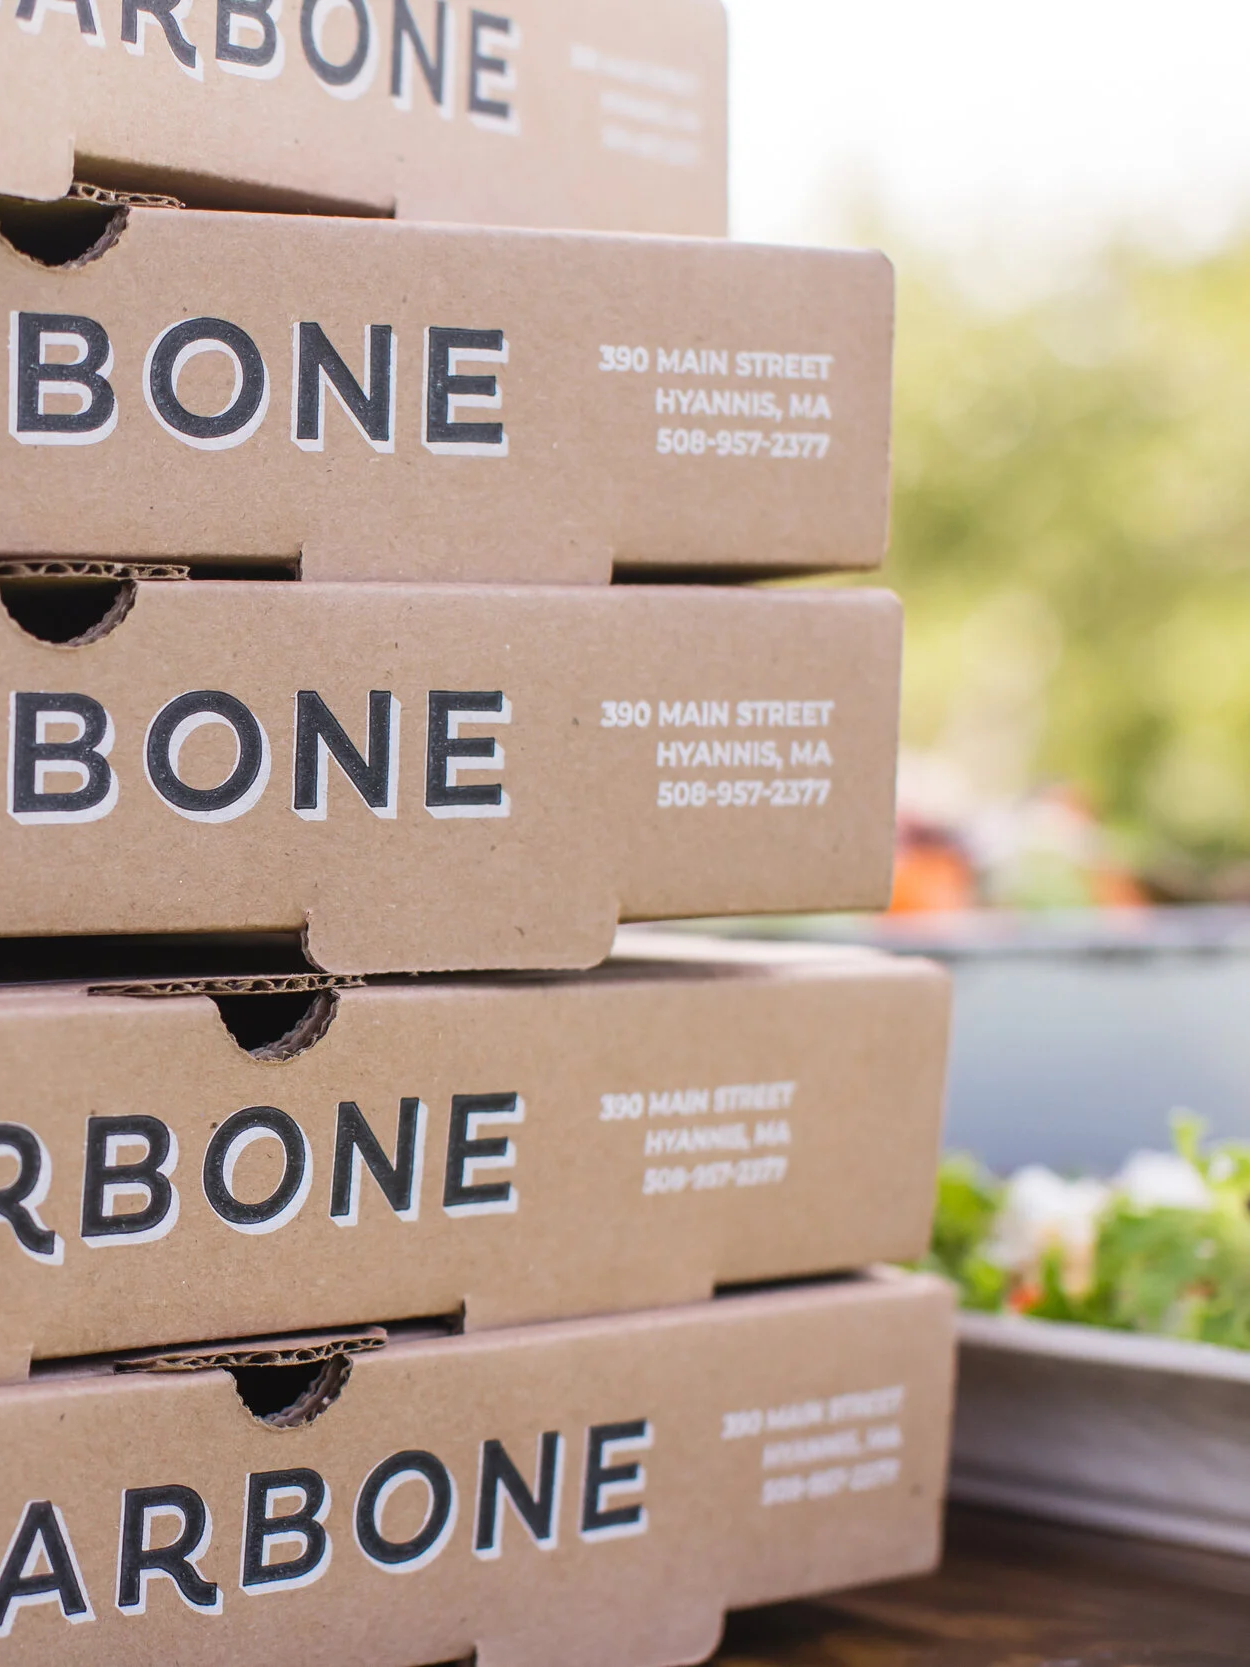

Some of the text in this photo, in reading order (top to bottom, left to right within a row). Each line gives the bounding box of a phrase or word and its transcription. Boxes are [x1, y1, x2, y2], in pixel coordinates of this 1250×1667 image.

[598, 345, 833, 380] 390 MAIN STREET
[655, 388, 831, 422] HYANNIS, MA
[656, 428, 830, 458] 508-957-2377
[601, 701, 834, 727] 390 MAIN STREET
[657, 740, 832, 771] HYANNIS, MA
[657, 778, 830, 807] 508-957-2377
[648, 1090, 709, 1116] MAIN
